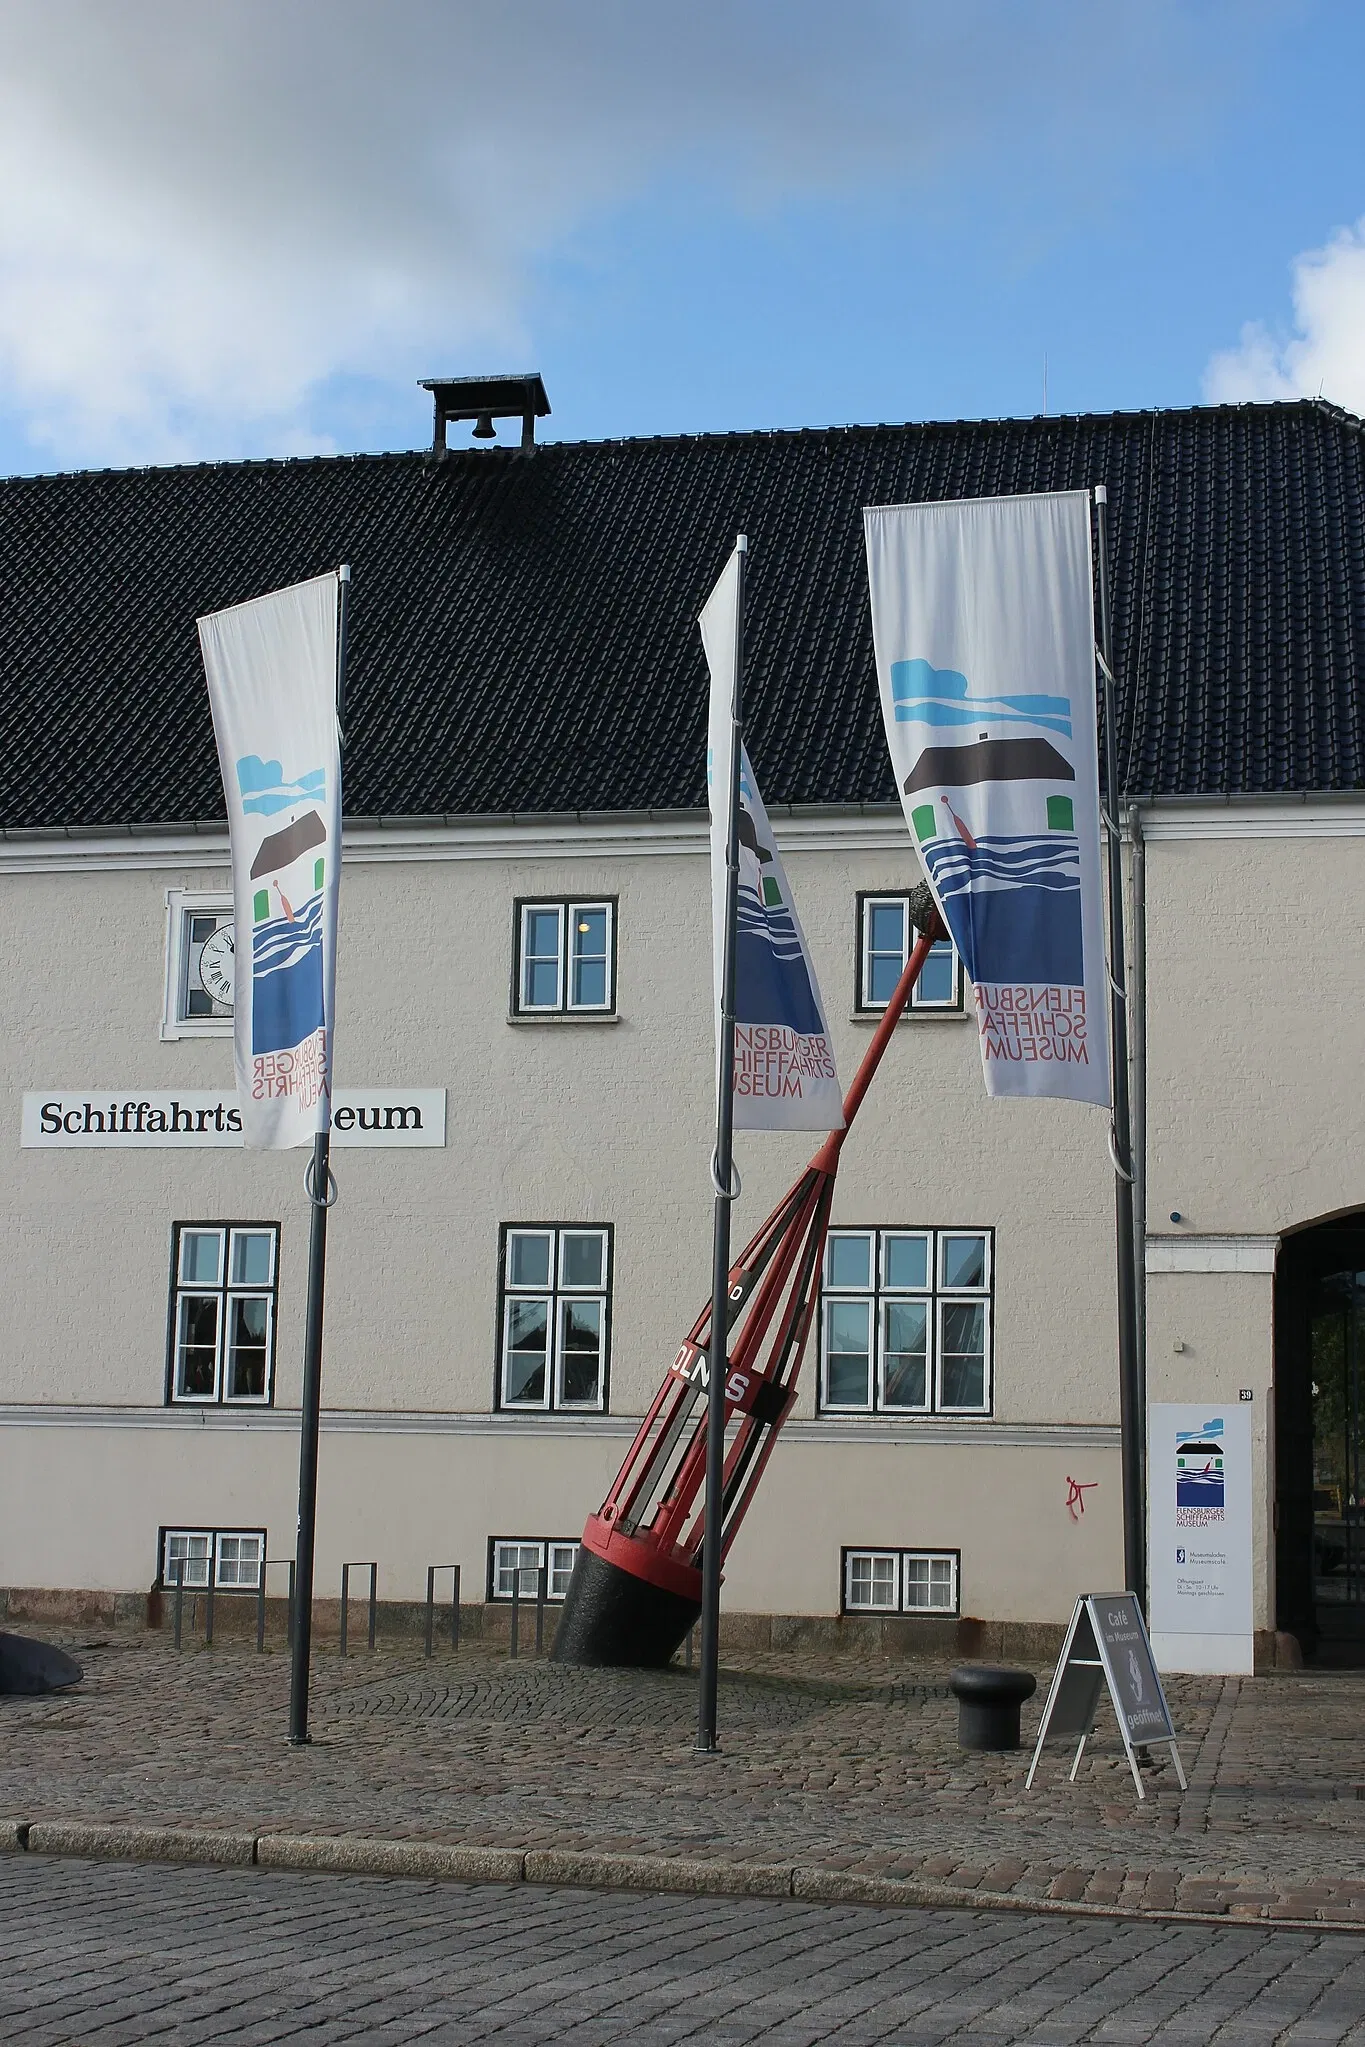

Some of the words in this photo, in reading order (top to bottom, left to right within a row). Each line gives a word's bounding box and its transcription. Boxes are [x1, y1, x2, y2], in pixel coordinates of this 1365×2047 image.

[1241, 1391, 1252, 1400] 39
[1108, 1611, 1128, 1626] Café
[1106, 1632, 1114, 1642] im
[1114, 1631, 1139, 1641] Museum
[1127, 1709, 1164, 1730] geöffnet
